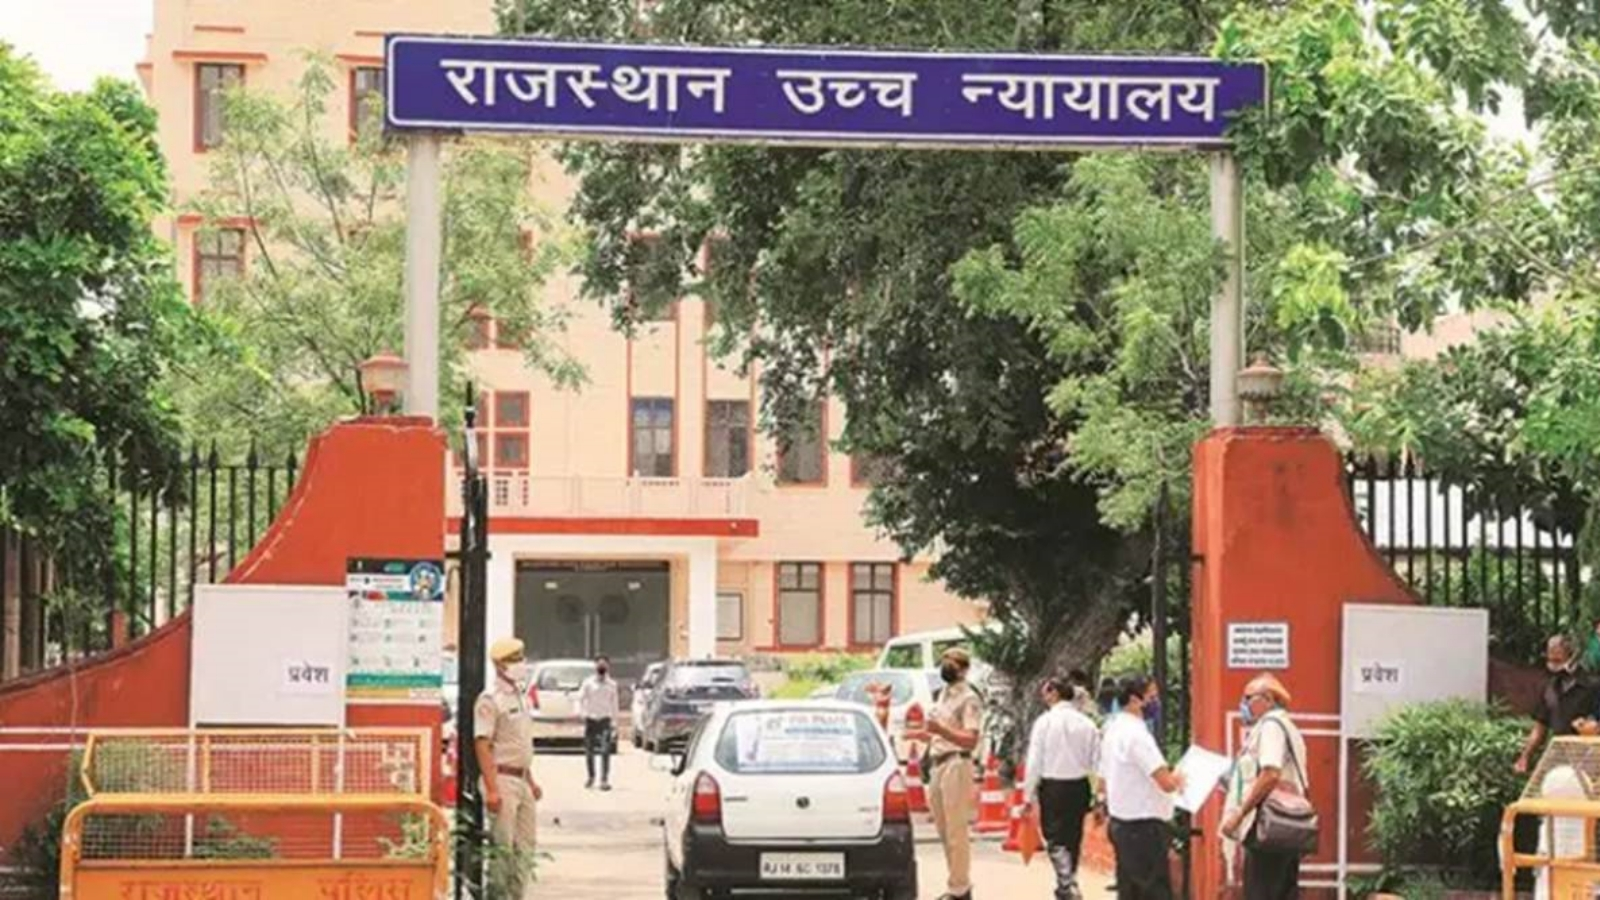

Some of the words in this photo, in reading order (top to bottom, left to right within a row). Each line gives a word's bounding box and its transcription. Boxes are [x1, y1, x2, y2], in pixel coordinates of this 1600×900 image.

[440, 59, 731, 113] राजस्थान
[776, 70, 917, 117] उच्च
[962, 74, 1220, 121] न्यायालय
[288, 660, 329, 683] प्रवेश
[1360, 661, 1399, 683] प्रवेश
[763, 862, 778, 875] RJ
[317, 870, 413, 900] पलिस
